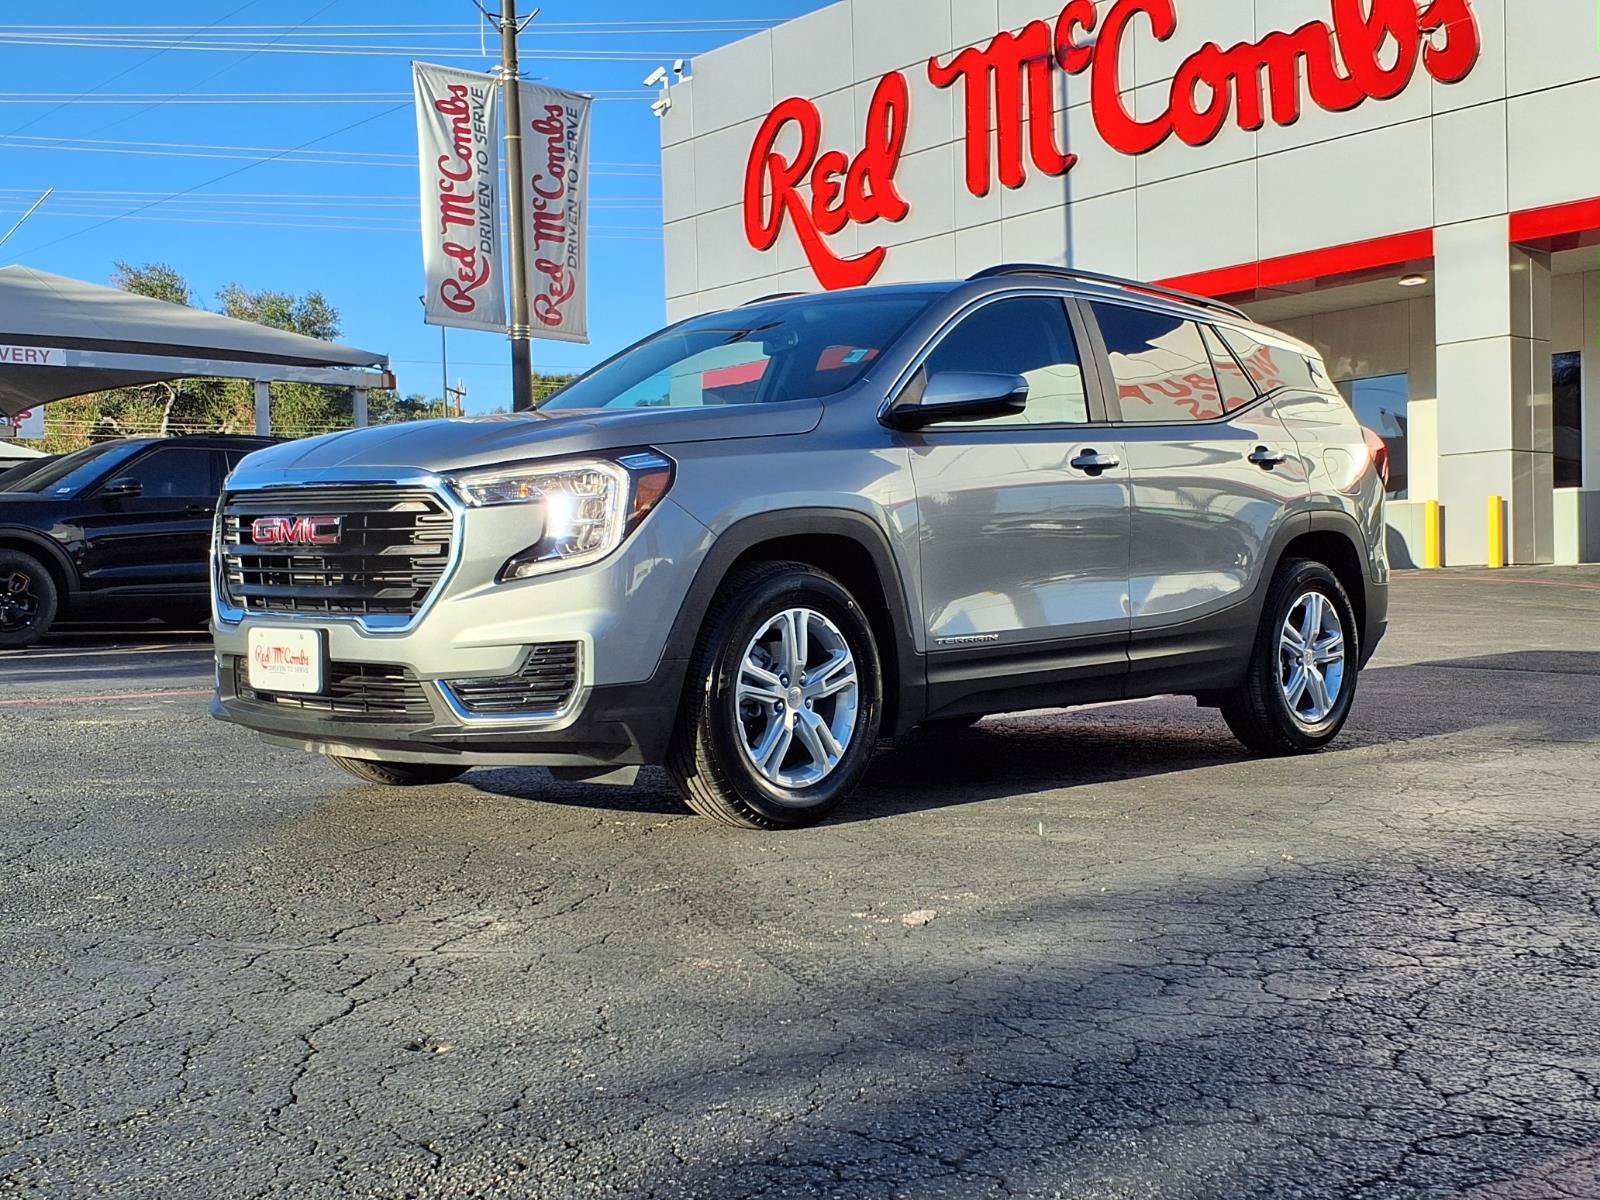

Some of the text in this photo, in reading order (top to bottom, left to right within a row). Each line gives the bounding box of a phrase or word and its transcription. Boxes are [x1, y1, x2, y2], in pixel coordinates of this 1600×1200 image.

[435, 84, 490, 314] Red McCombs
[471, 87, 492, 255] DRIVEN TO SERVE
[531, 104, 575, 327] Red McCombs
[566, 106, 579, 270] DRIVEN TO SERVE
[744, 0, 1482, 289] Red McCombs
[0, 347, 50, 363] VERY
[252, 516, 341, 545] GMC
[255, 645, 309, 669] Red McCombs
[935, 633, 999, 645] TERRAIN
